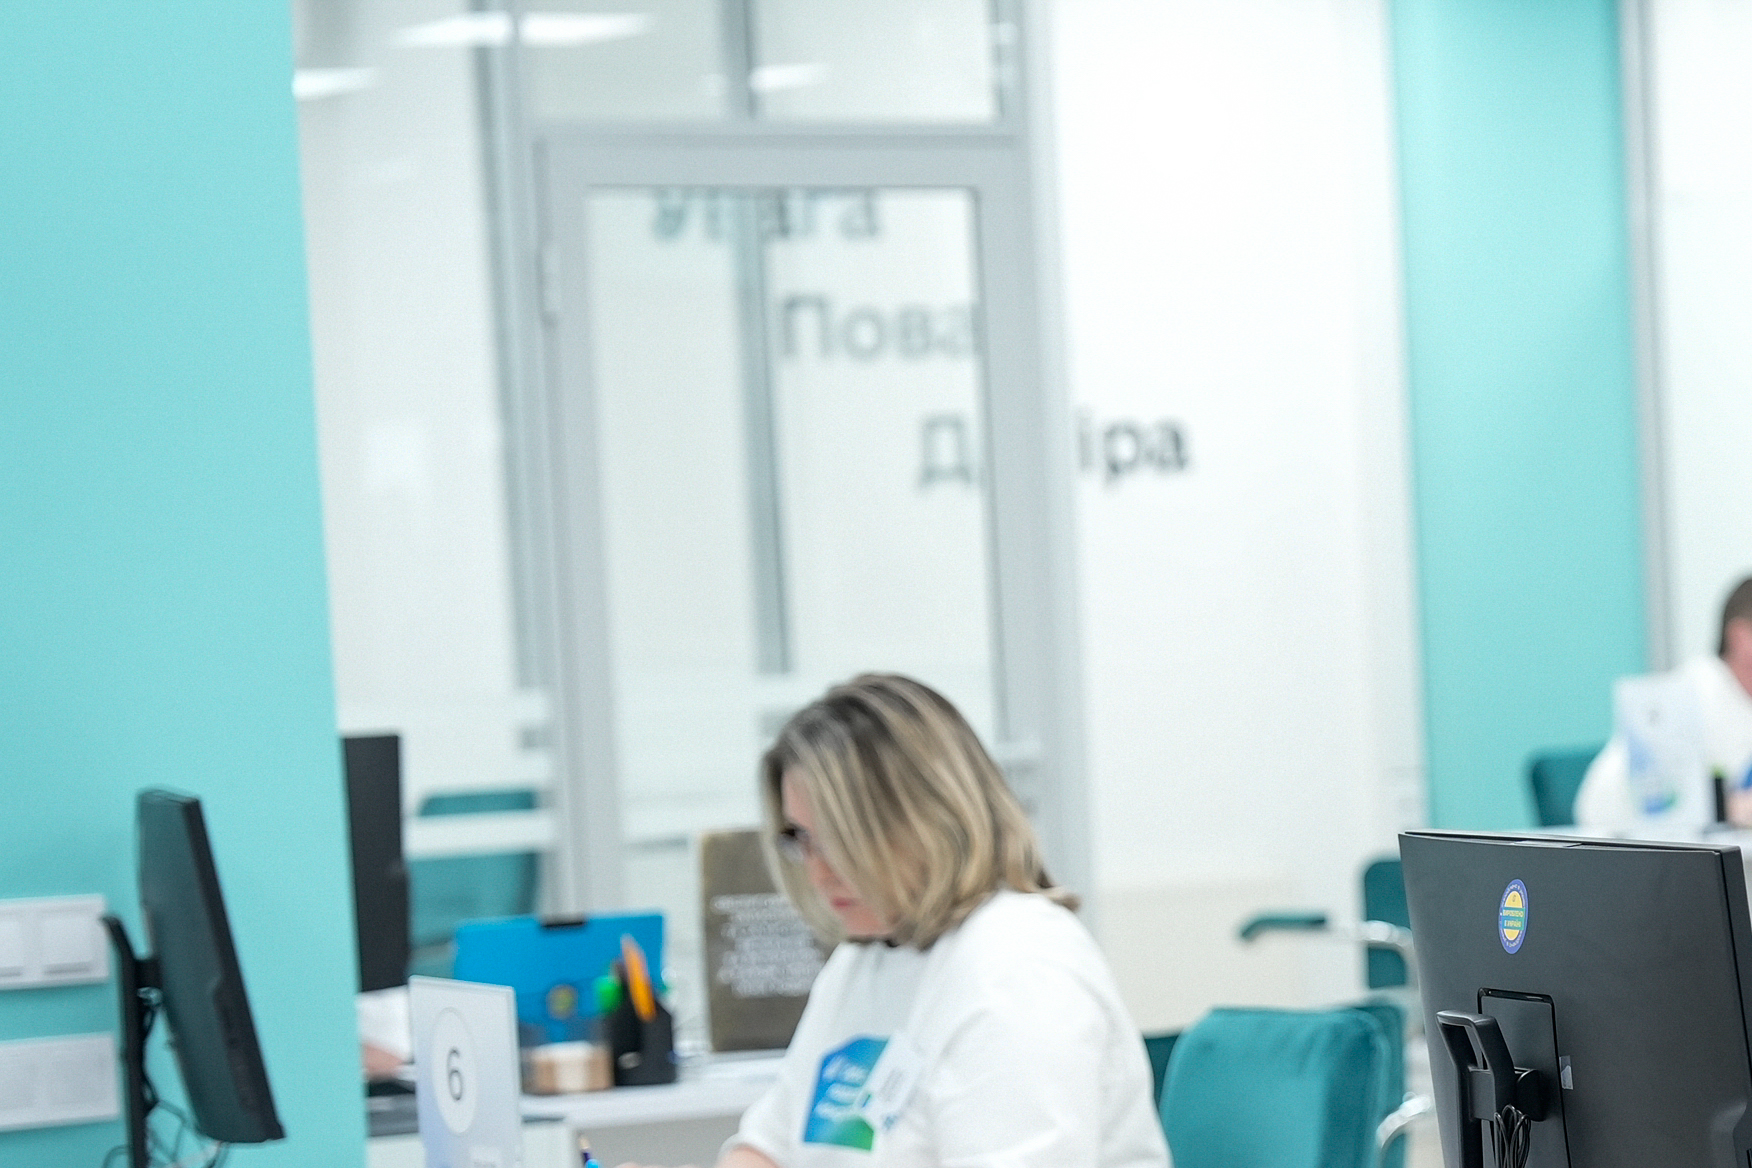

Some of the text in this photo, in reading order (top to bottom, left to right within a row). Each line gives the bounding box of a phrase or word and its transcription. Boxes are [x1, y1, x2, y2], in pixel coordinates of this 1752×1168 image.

[780, 291, 984, 360] Пова
[916, 408, 1192, 492] Діра
[446, 1046, 465, 1102] 6
